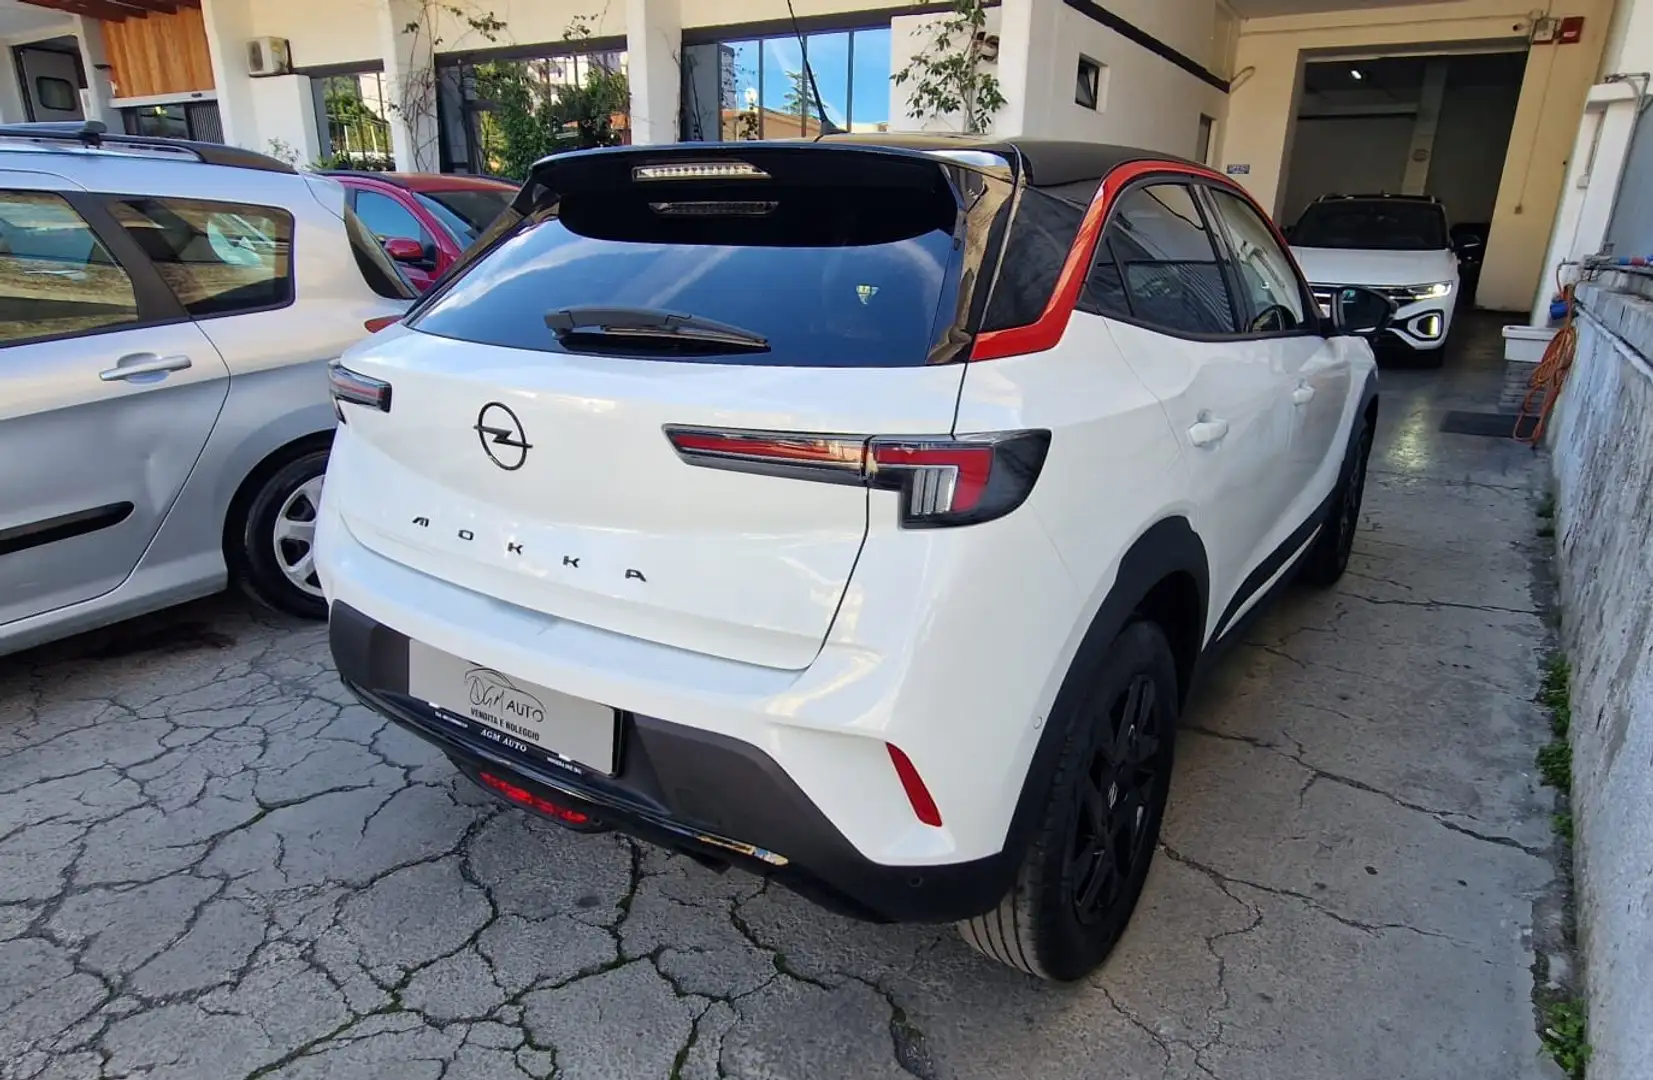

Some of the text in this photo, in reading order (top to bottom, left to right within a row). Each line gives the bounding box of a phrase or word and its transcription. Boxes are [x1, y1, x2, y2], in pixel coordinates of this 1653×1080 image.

[412, 516, 647, 582] MOKKA
[471, 707, 498, 724] VENDITA
[499, 718, 505, 728] E
[505, 721, 540, 742] NOLEGGIO
[506, 699, 545, 723] AUTO
[480, 729, 528, 753] AGM AUTO
